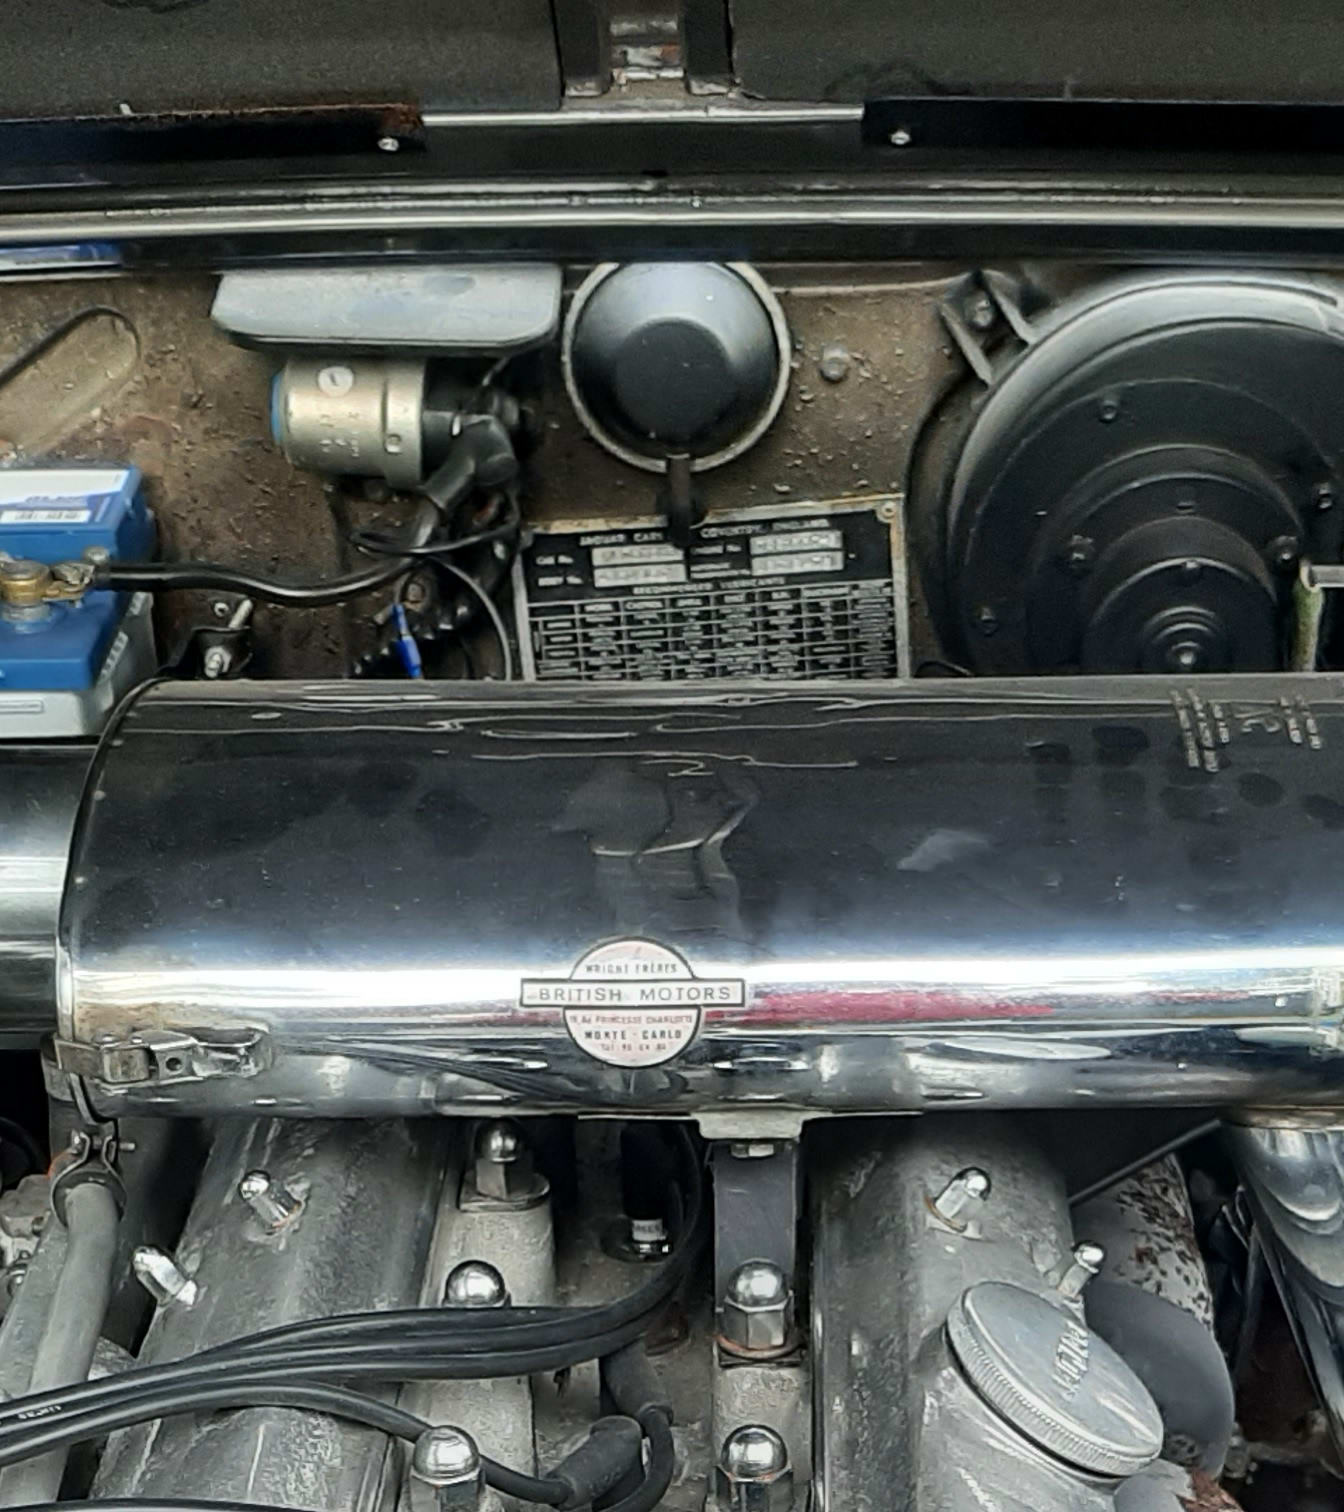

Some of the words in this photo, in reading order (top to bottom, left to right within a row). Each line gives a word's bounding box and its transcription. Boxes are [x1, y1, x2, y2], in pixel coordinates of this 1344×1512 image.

[539, 986, 622, 1003] BRITISH
[639, 985, 732, 1002] MOTORS
[584, 1030, 627, 1040] MONTE
[641, 1029, 682, 1040] CARLO
